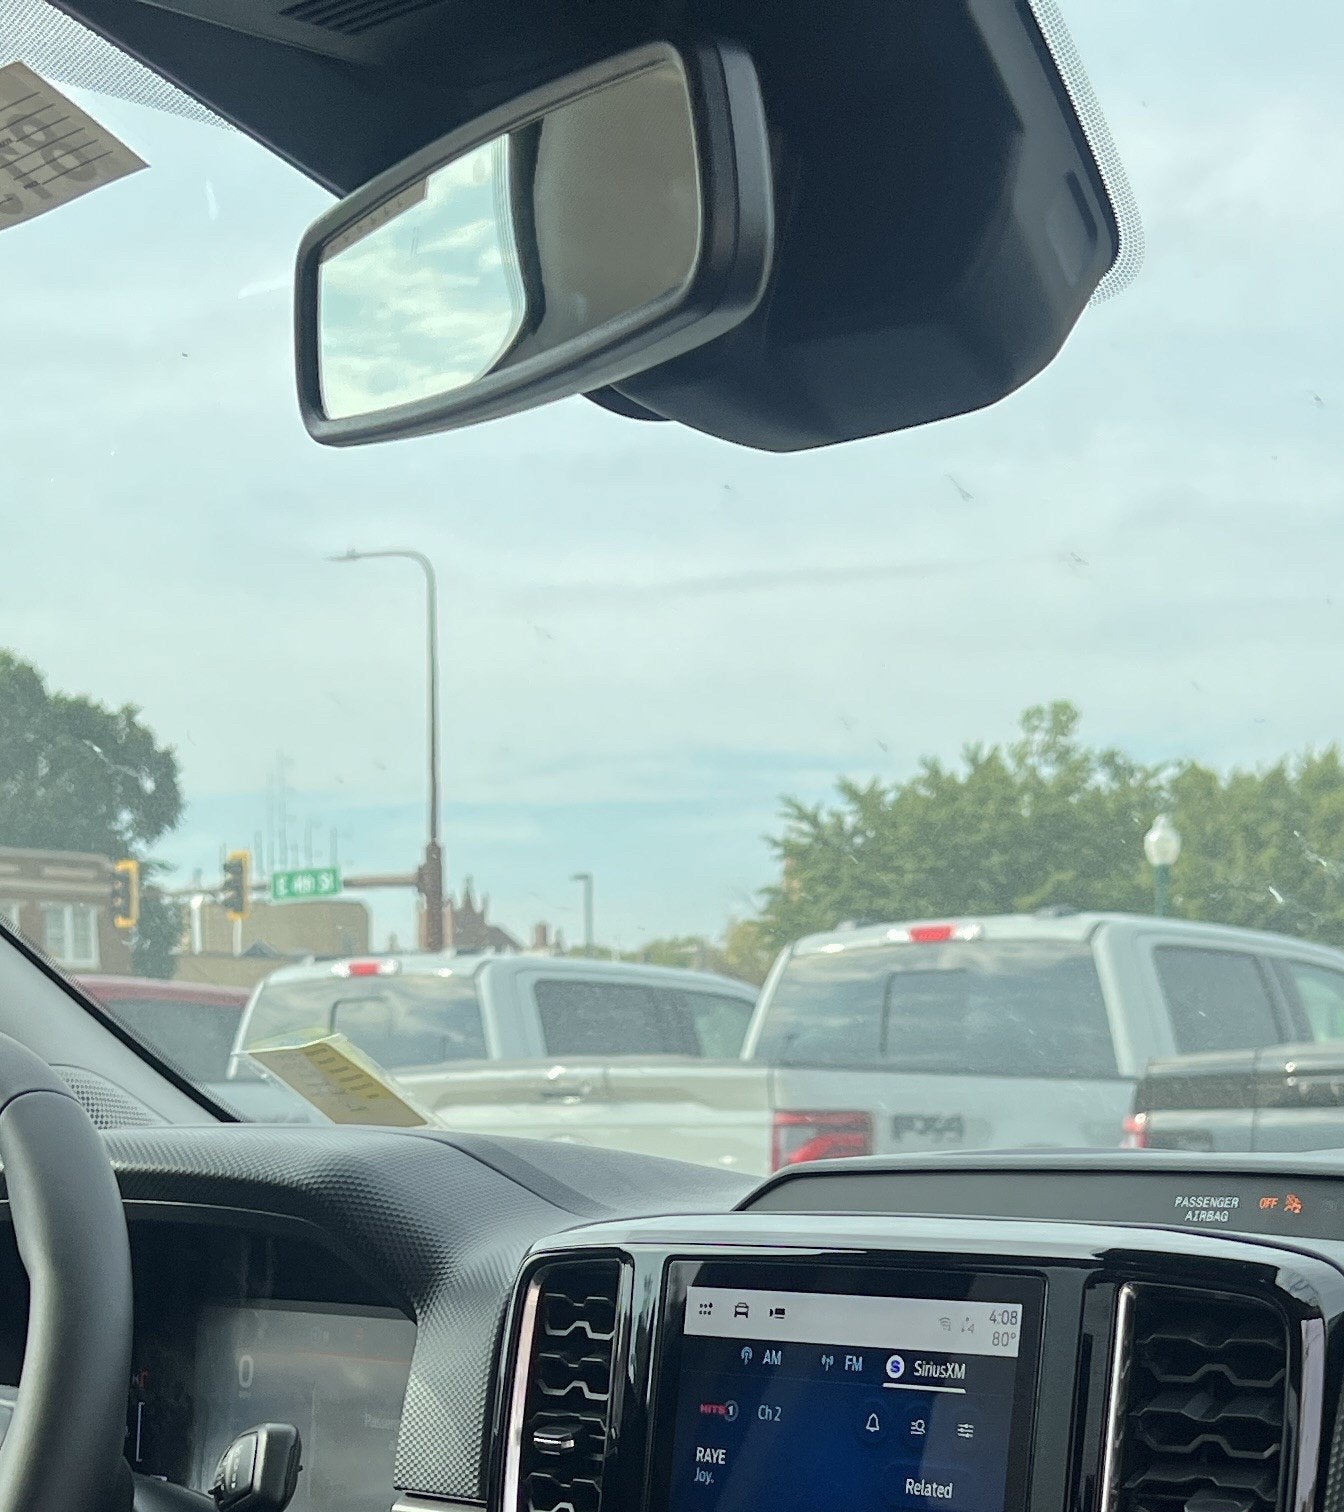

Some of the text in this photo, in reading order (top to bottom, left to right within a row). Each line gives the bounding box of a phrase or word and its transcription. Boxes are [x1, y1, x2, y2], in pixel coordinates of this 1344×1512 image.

[1174, 1196, 1279, 1209] PASSENGER OFF
[1184, 1210, 1229, 1222] AIRBAG
[989, 1309, 1018, 1326] 4:08
[762, 1350, 782, 1366] AM
[844, 1355, 863, 1372] FM
[913, 1360, 966, 1380] SiriusXM
[758, 1404, 782, 1421] Ch 2
[696, 1446, 727, 1465] RAYE
[693, 1466, 715, 1486] Joy.
[906, 1478, 953, 1499] Related
